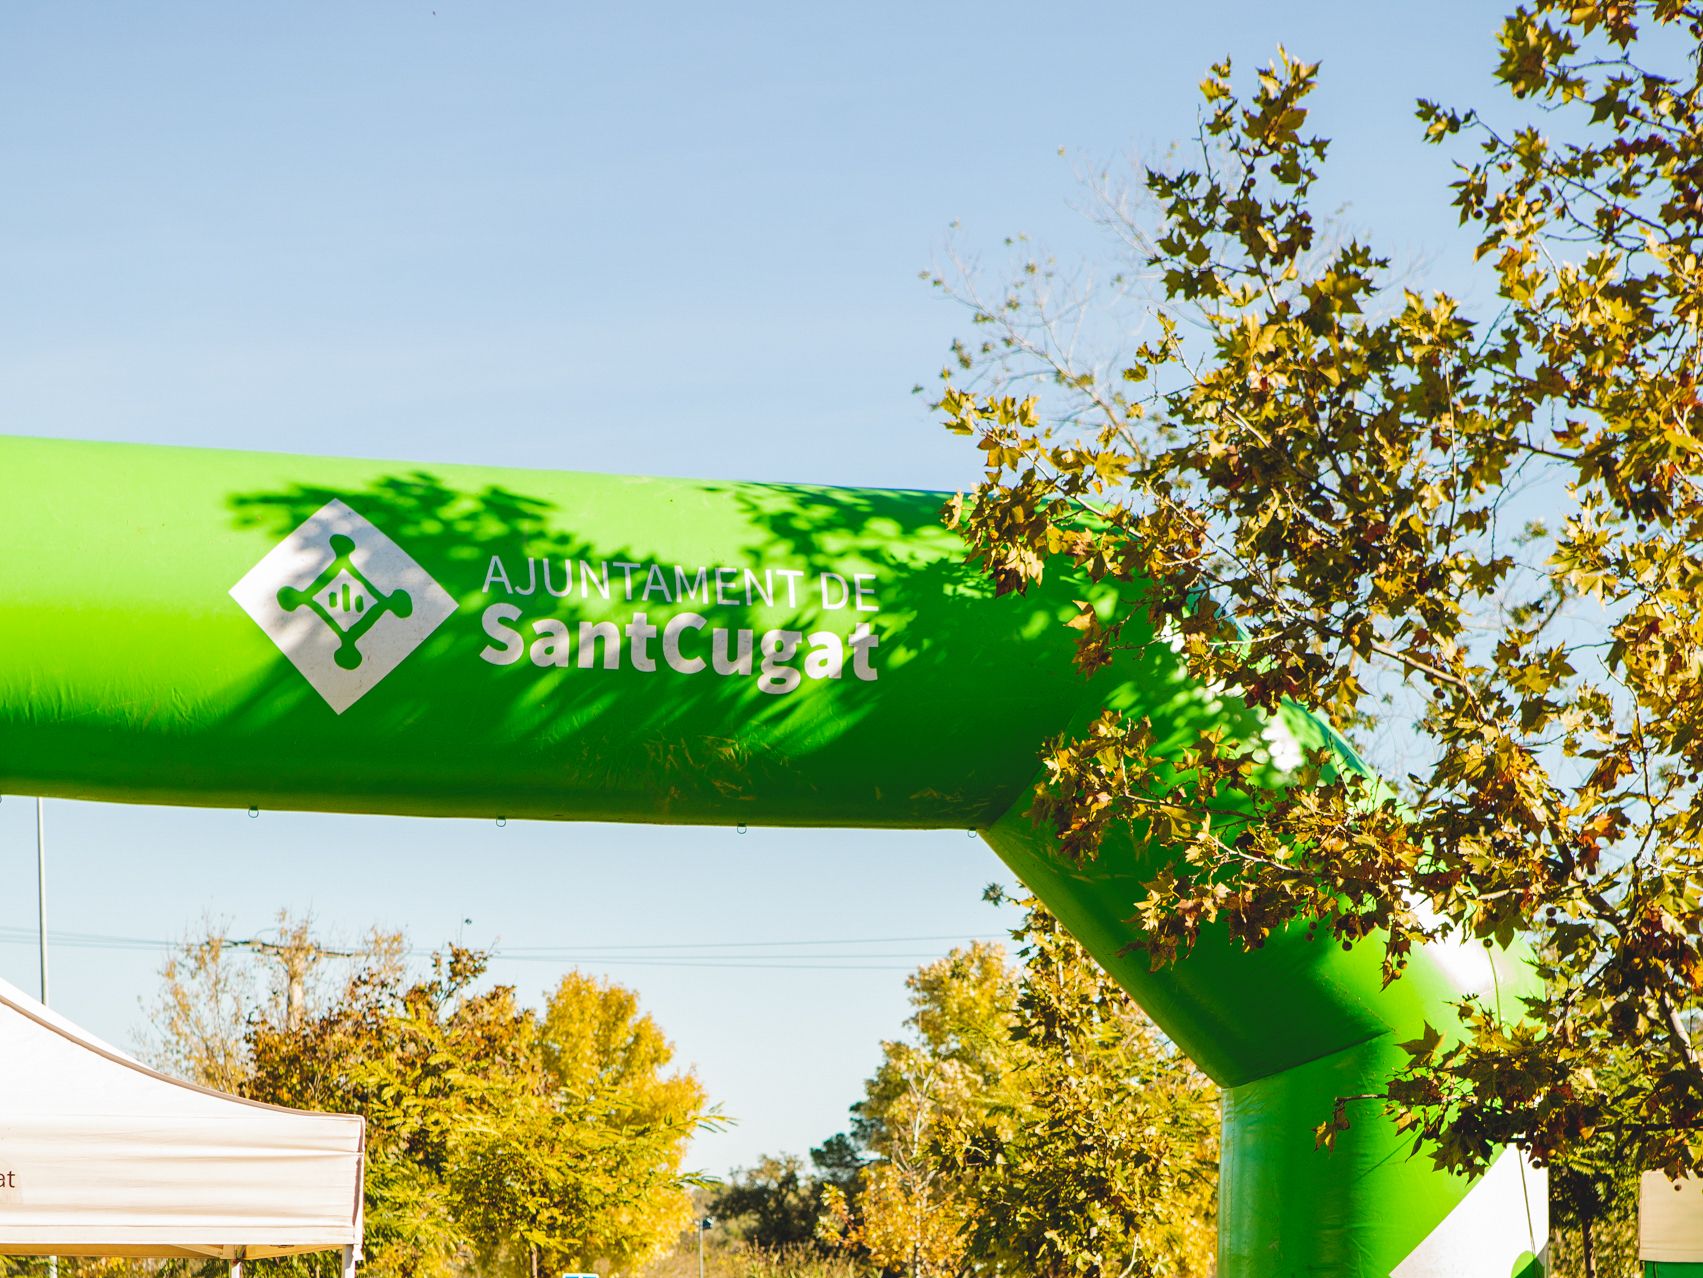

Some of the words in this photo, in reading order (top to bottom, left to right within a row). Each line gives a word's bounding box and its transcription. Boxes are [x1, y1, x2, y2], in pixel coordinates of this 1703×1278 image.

[482, 554, 804, 609] AJUNTAMENT
[820, 571, 878, 612] DE
[479, 602, 879, 695] SantCugat
